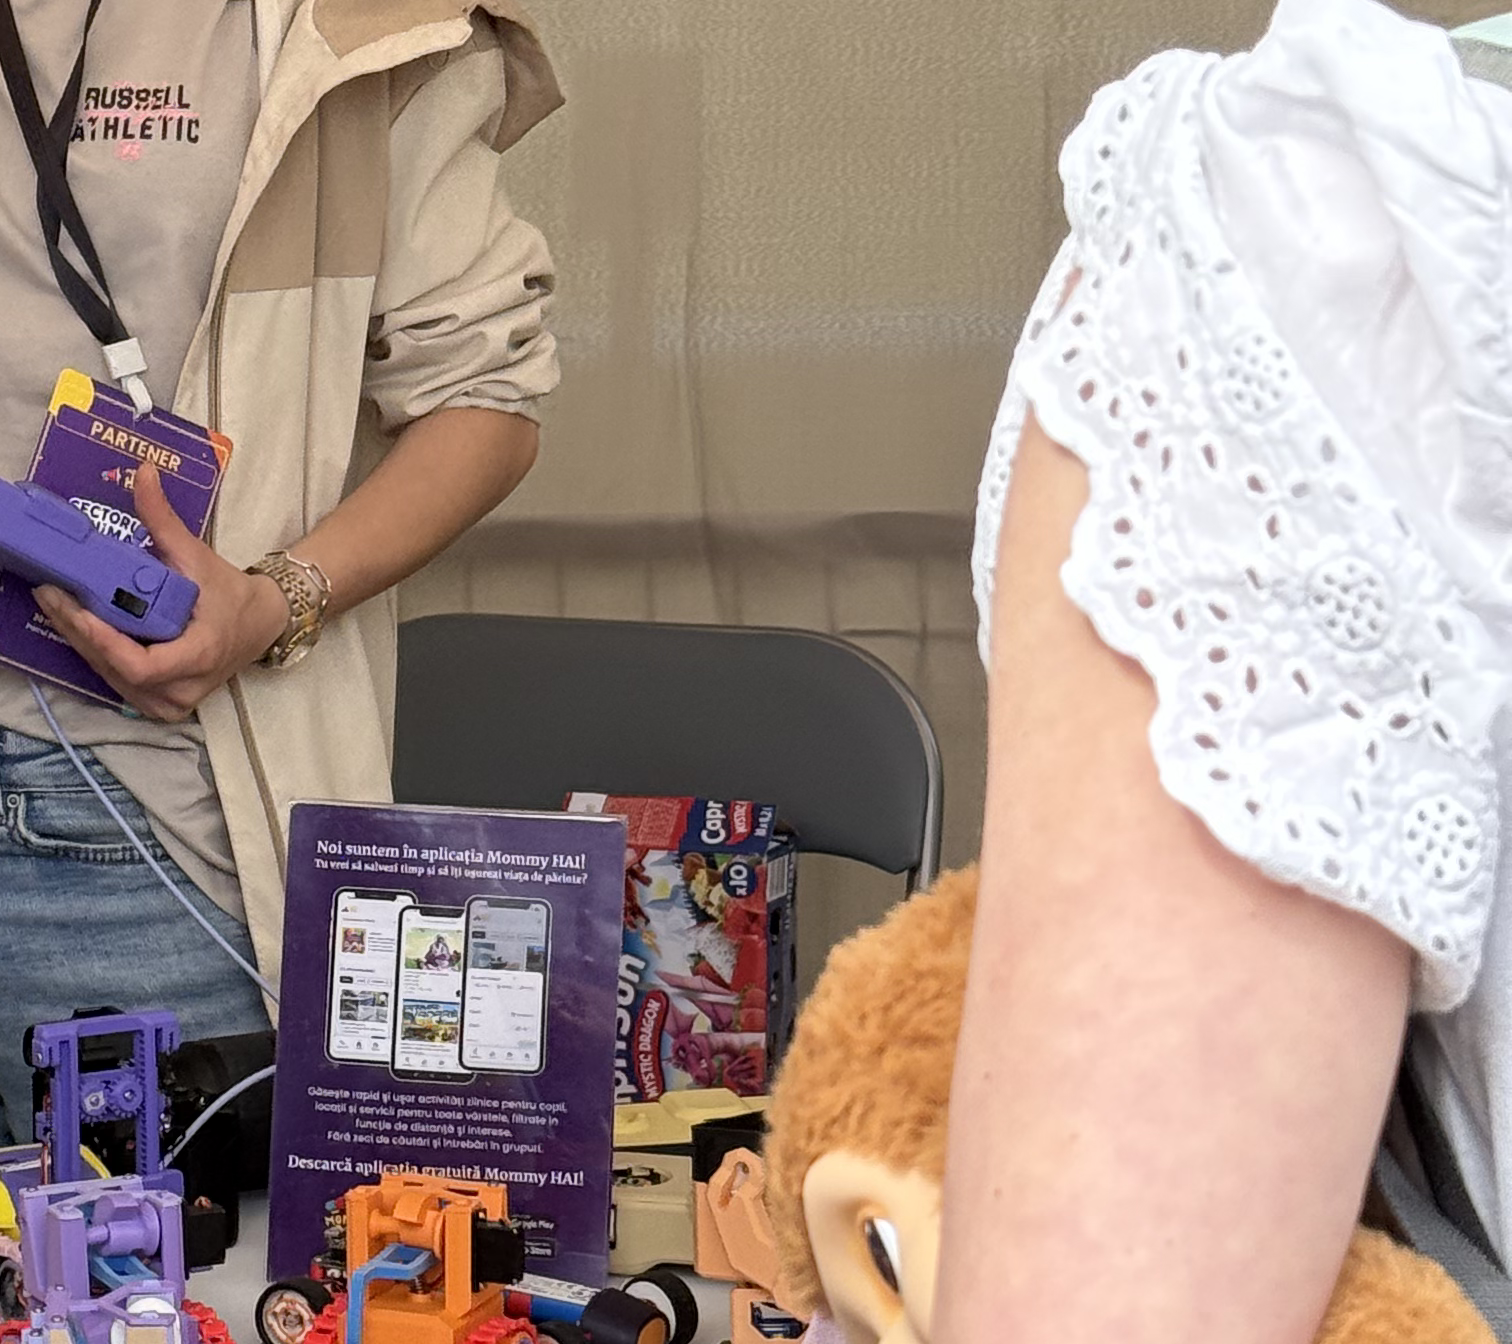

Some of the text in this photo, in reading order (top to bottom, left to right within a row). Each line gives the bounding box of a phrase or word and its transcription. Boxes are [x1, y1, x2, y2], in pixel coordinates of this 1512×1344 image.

[71, 115, 200, 143] ATHLETIC
[90, 420, 182, 472] PARTENER
[317, 840, 586, 870] Noi suntem în aplicația Mommy HAI!
[400, 863, 424, 877] timp
[531, 871, 543, 882] de
[729, 864, 748, 896] x10
[638, 998, 662, 1100] MYSTIC DRAGON
[397, 1108, 432, 1119] pentru
[501, 1100, 537, 1111] pentru
[394, 1120, 408, 1131] de
[376, 1135, 390, 1145] de
[288, 1154, 353, 1172] Descarcă
[484, 1167, 548, 1187] Mommy
[550, 1171, 585, 1186] HAI!
